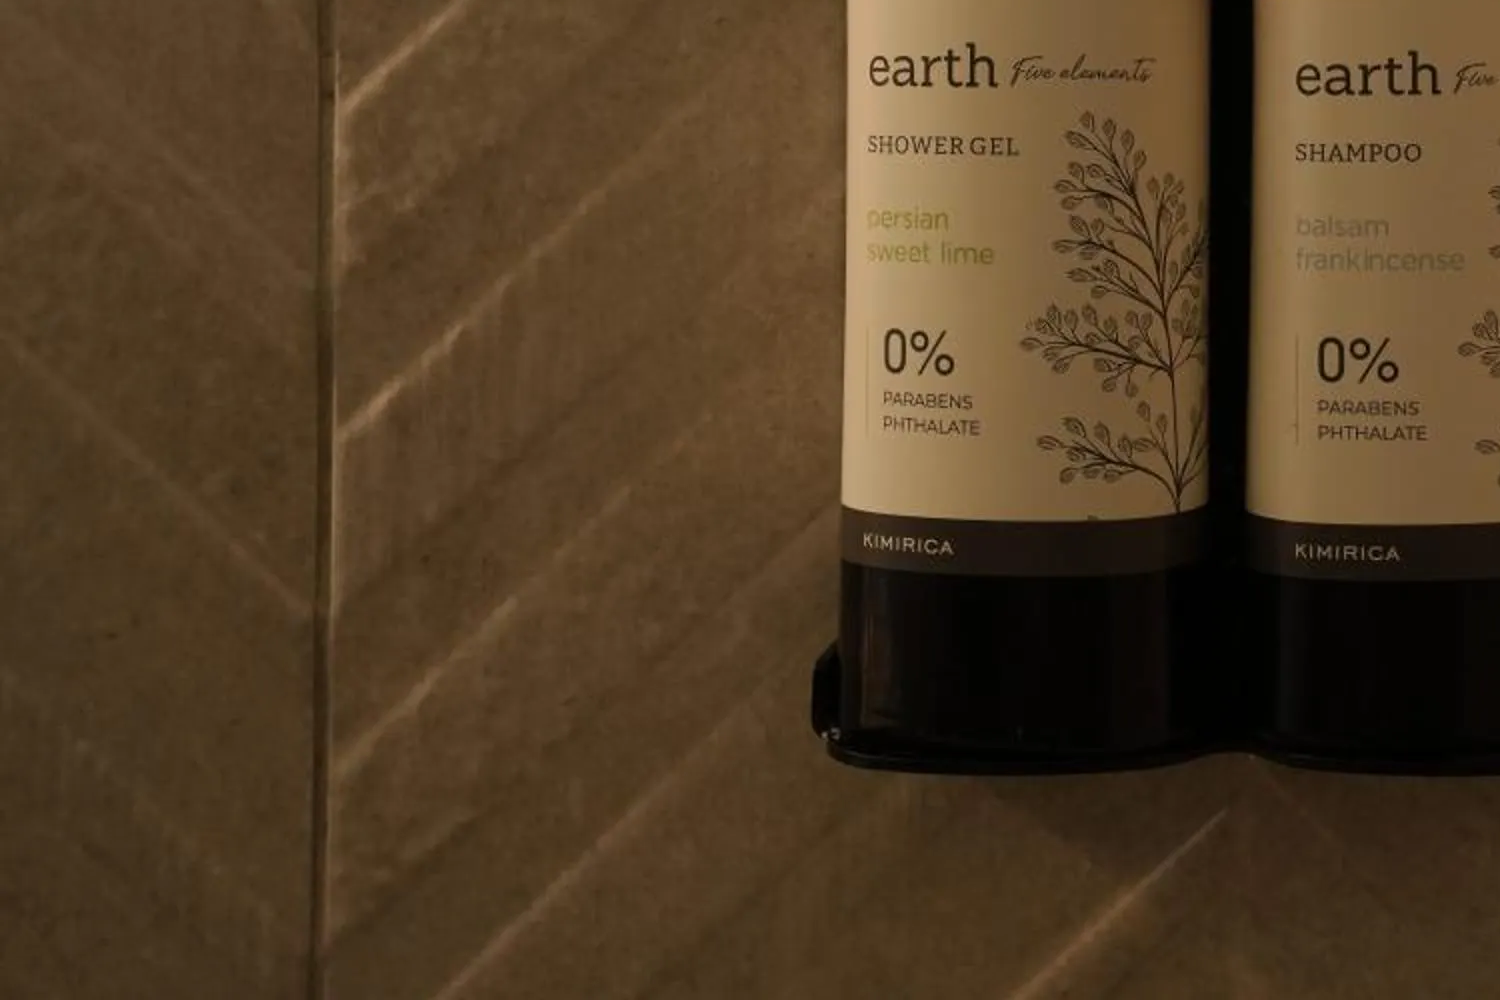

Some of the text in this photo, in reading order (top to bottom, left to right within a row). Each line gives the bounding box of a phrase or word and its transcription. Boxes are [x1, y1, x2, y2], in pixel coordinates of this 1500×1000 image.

[868, 42, 1157, 88] earth Five elements
[1296, 50, 1441, 96] earth
[1453, 62, 1497, 94] Five
[867, 135, 1020, 157] SHOWER GEL
[1295, 143, 1422, 163] SHAMPOO
[867, 207, 949, 235] persian
[1296, 215, 1390, 237] balsam
[866, 242, 994, 265] sweet lime
[1296, 247, 1465, 273] frankincense
[883, 327, 955, 376] 0%
[1317, 336, 1400, 384] 0%
[882, 390, 974, 410] PARABENS
[1317, 400, 1420, 417] PARABENS
[882, 415, 981, 437] PHTHALATE
[1317, 424, 1428, 441] PHTHALATE
[863, 531, 955, 555] KIMIRICA
[1294, 542, 1401, 562] KIMIRICA
